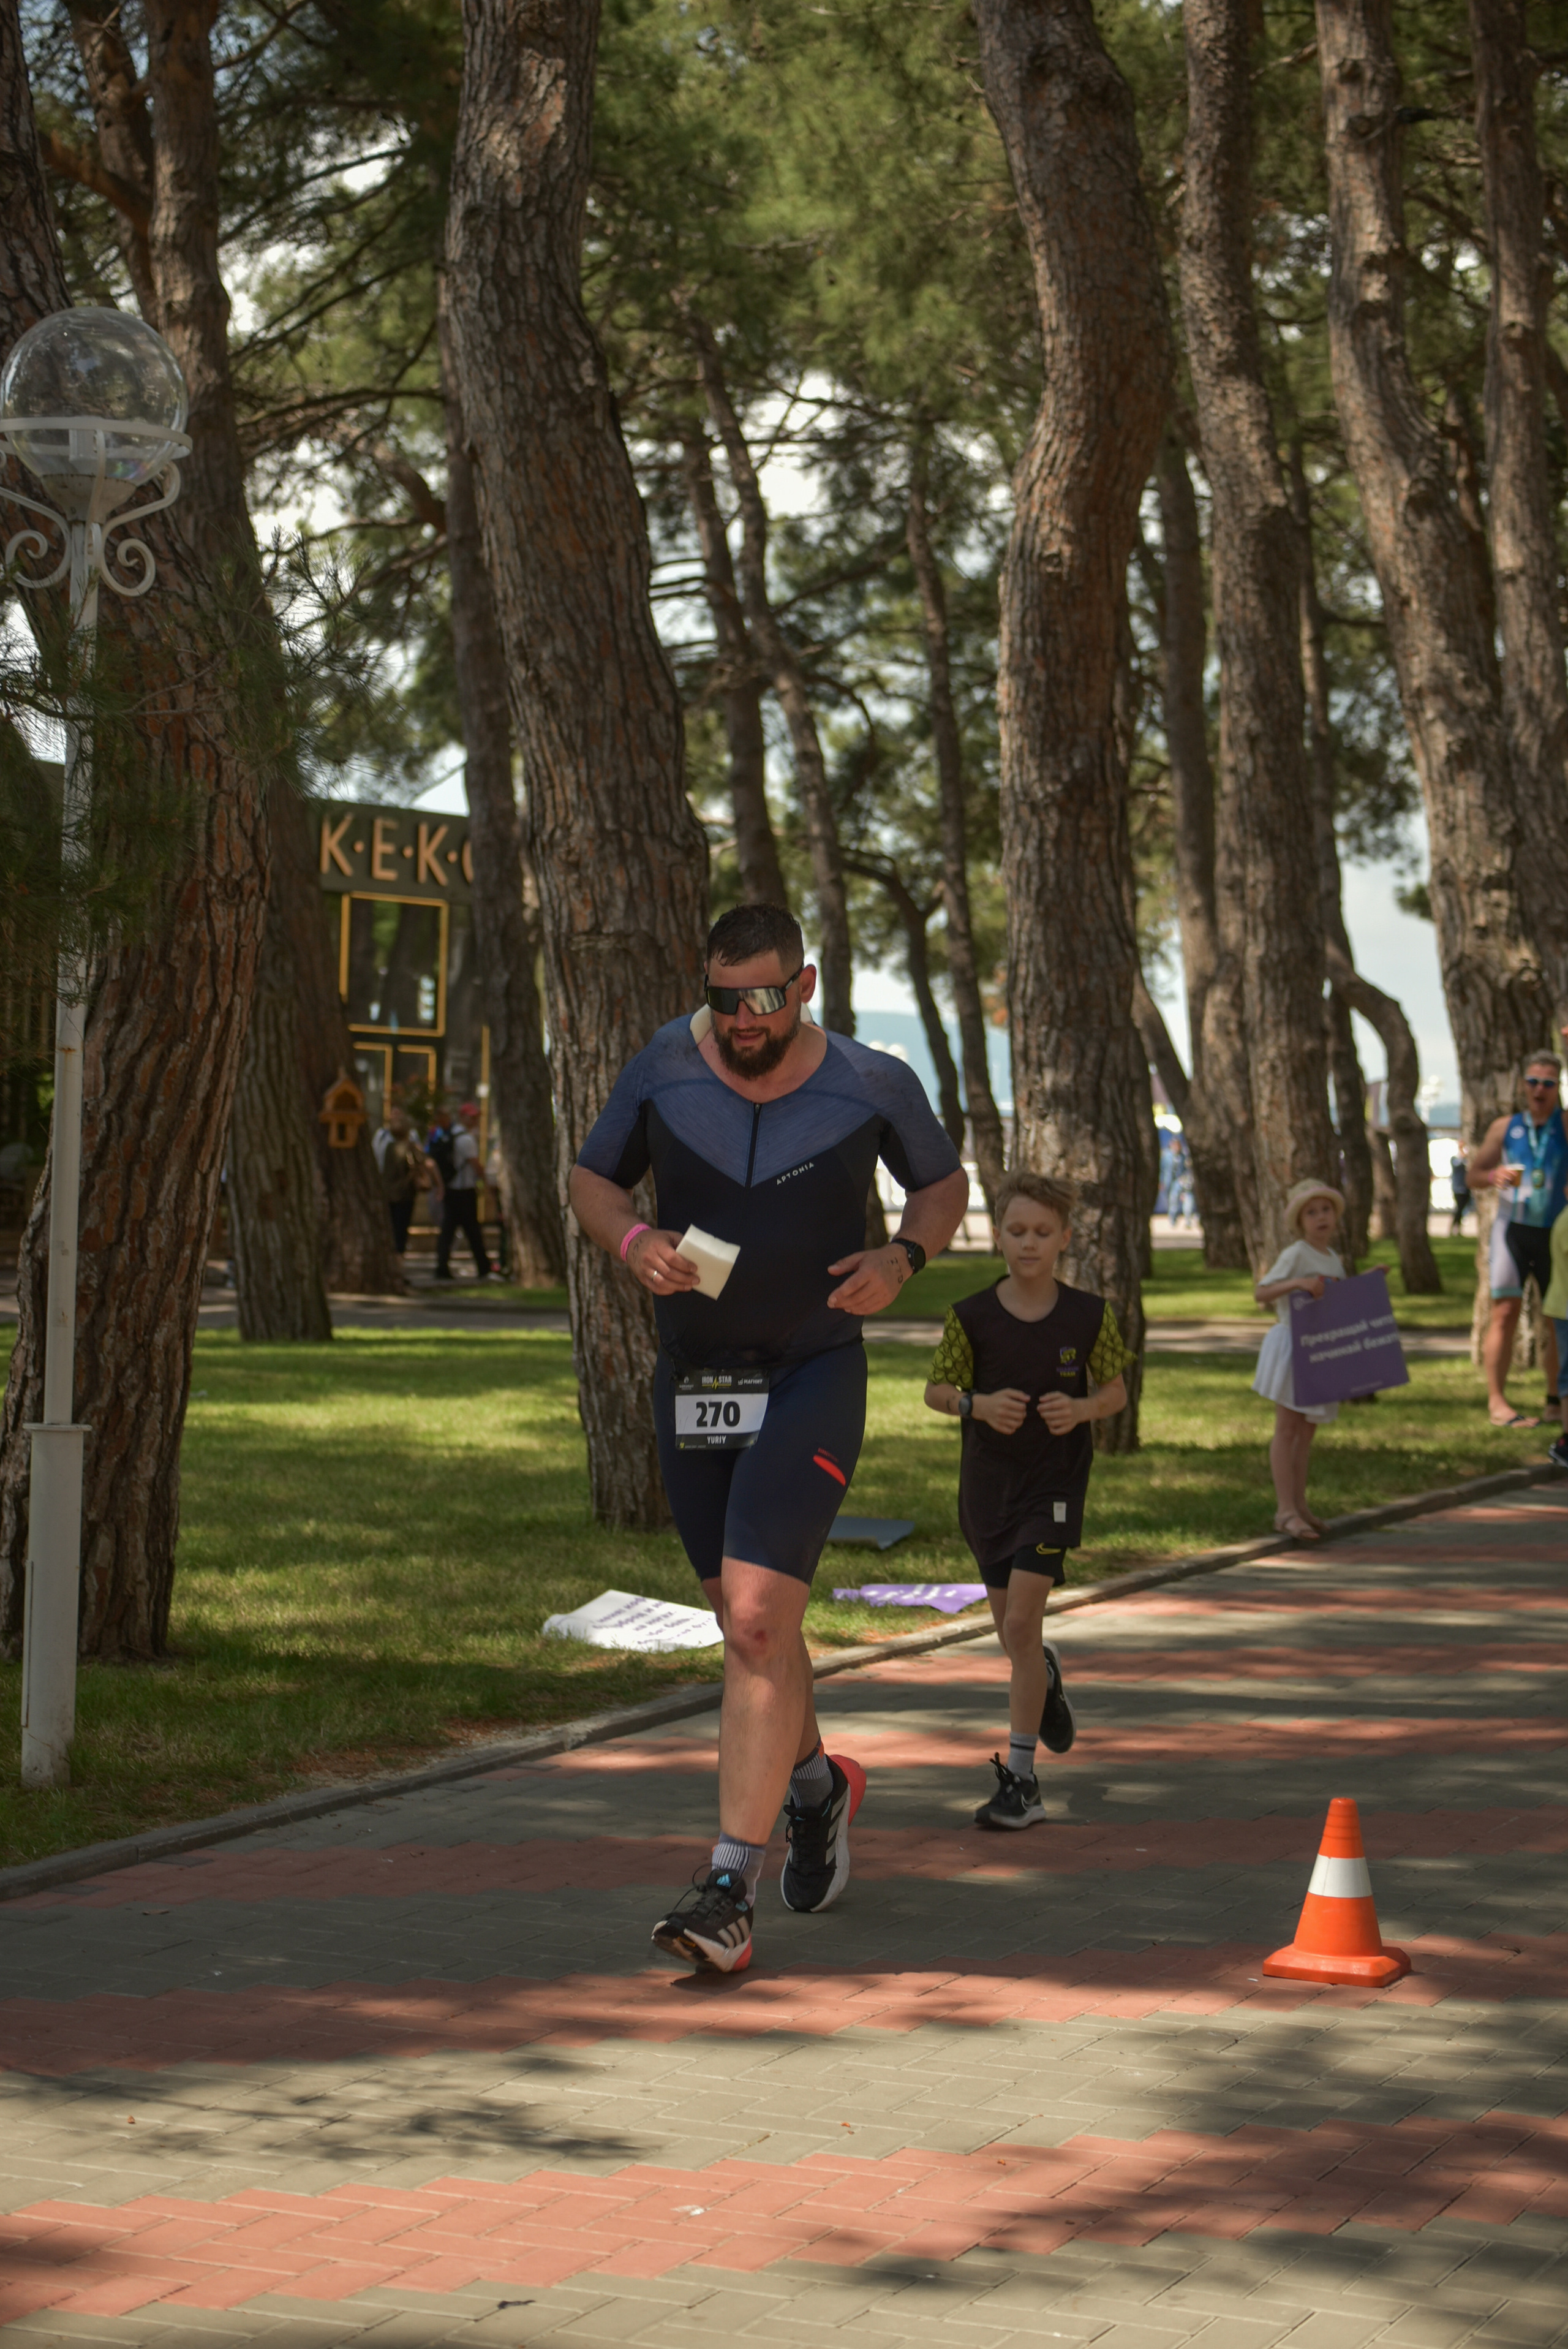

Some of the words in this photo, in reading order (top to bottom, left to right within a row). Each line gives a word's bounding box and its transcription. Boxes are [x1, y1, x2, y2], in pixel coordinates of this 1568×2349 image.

[777, 1162, 815, 1186] APTONIA
[701, 1375, 714, 1385] IRON
[718, 1375, 732, 1384] STAR
[695, 1401, 741, 1428] 270
[707, 1435, 727, 1445] YURIY
